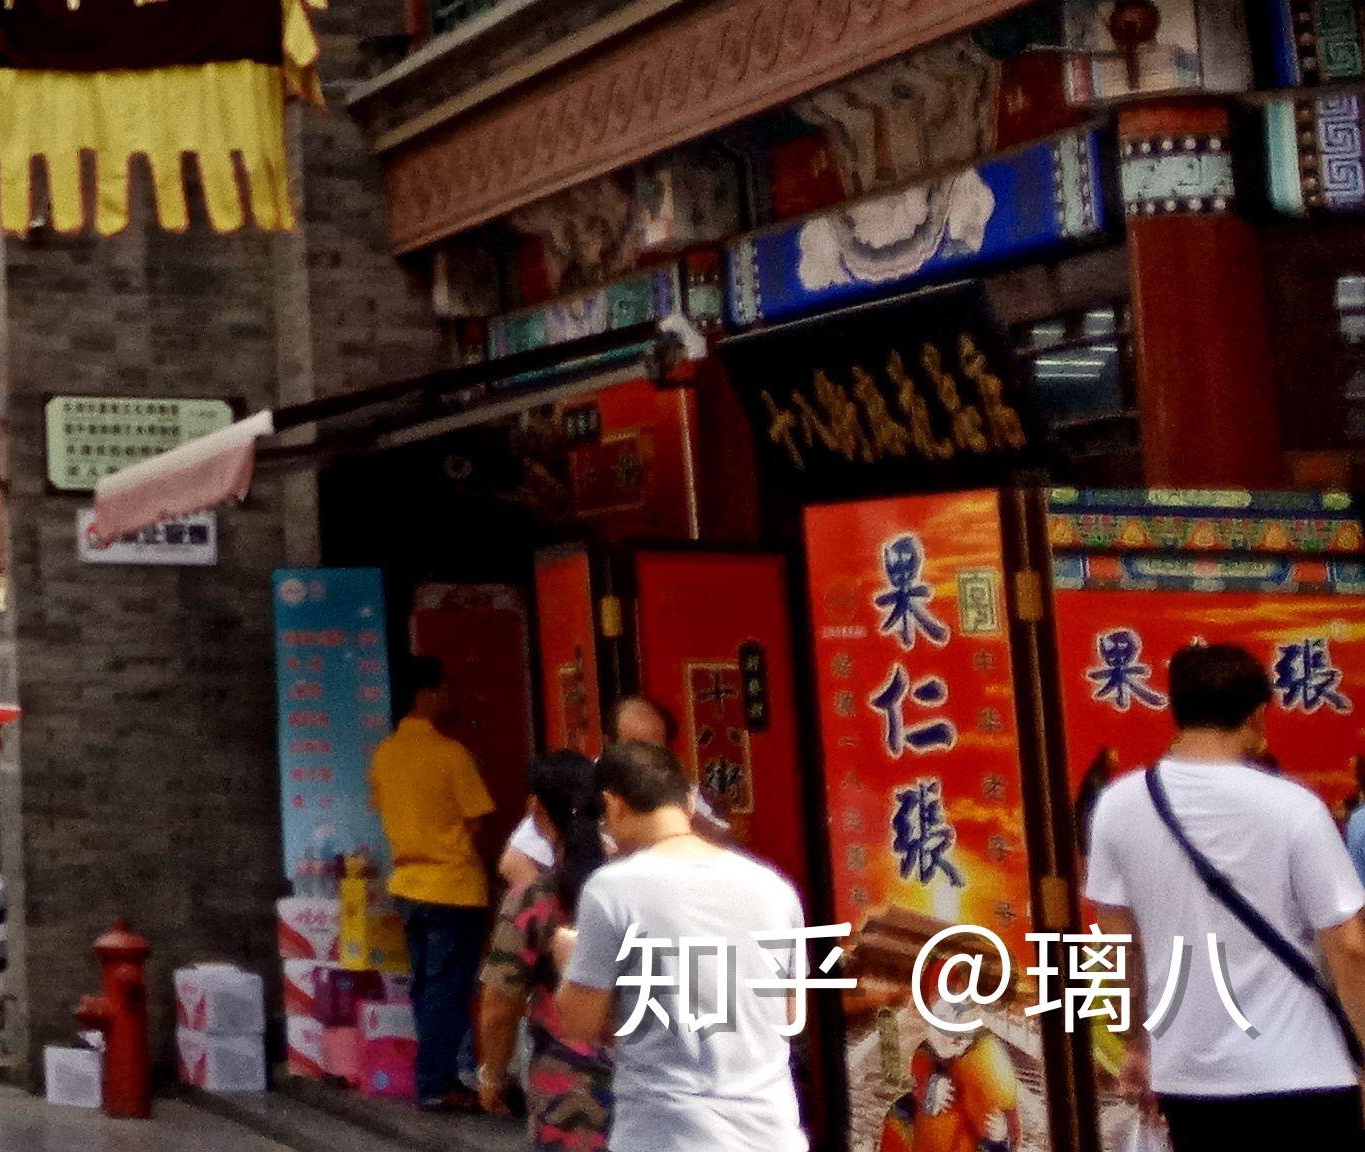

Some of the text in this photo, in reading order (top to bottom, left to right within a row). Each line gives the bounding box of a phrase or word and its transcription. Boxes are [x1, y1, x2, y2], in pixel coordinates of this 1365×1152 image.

[870, 532, 967, 888] 果仁張
[1083, 627, 1353, 715] 果張
